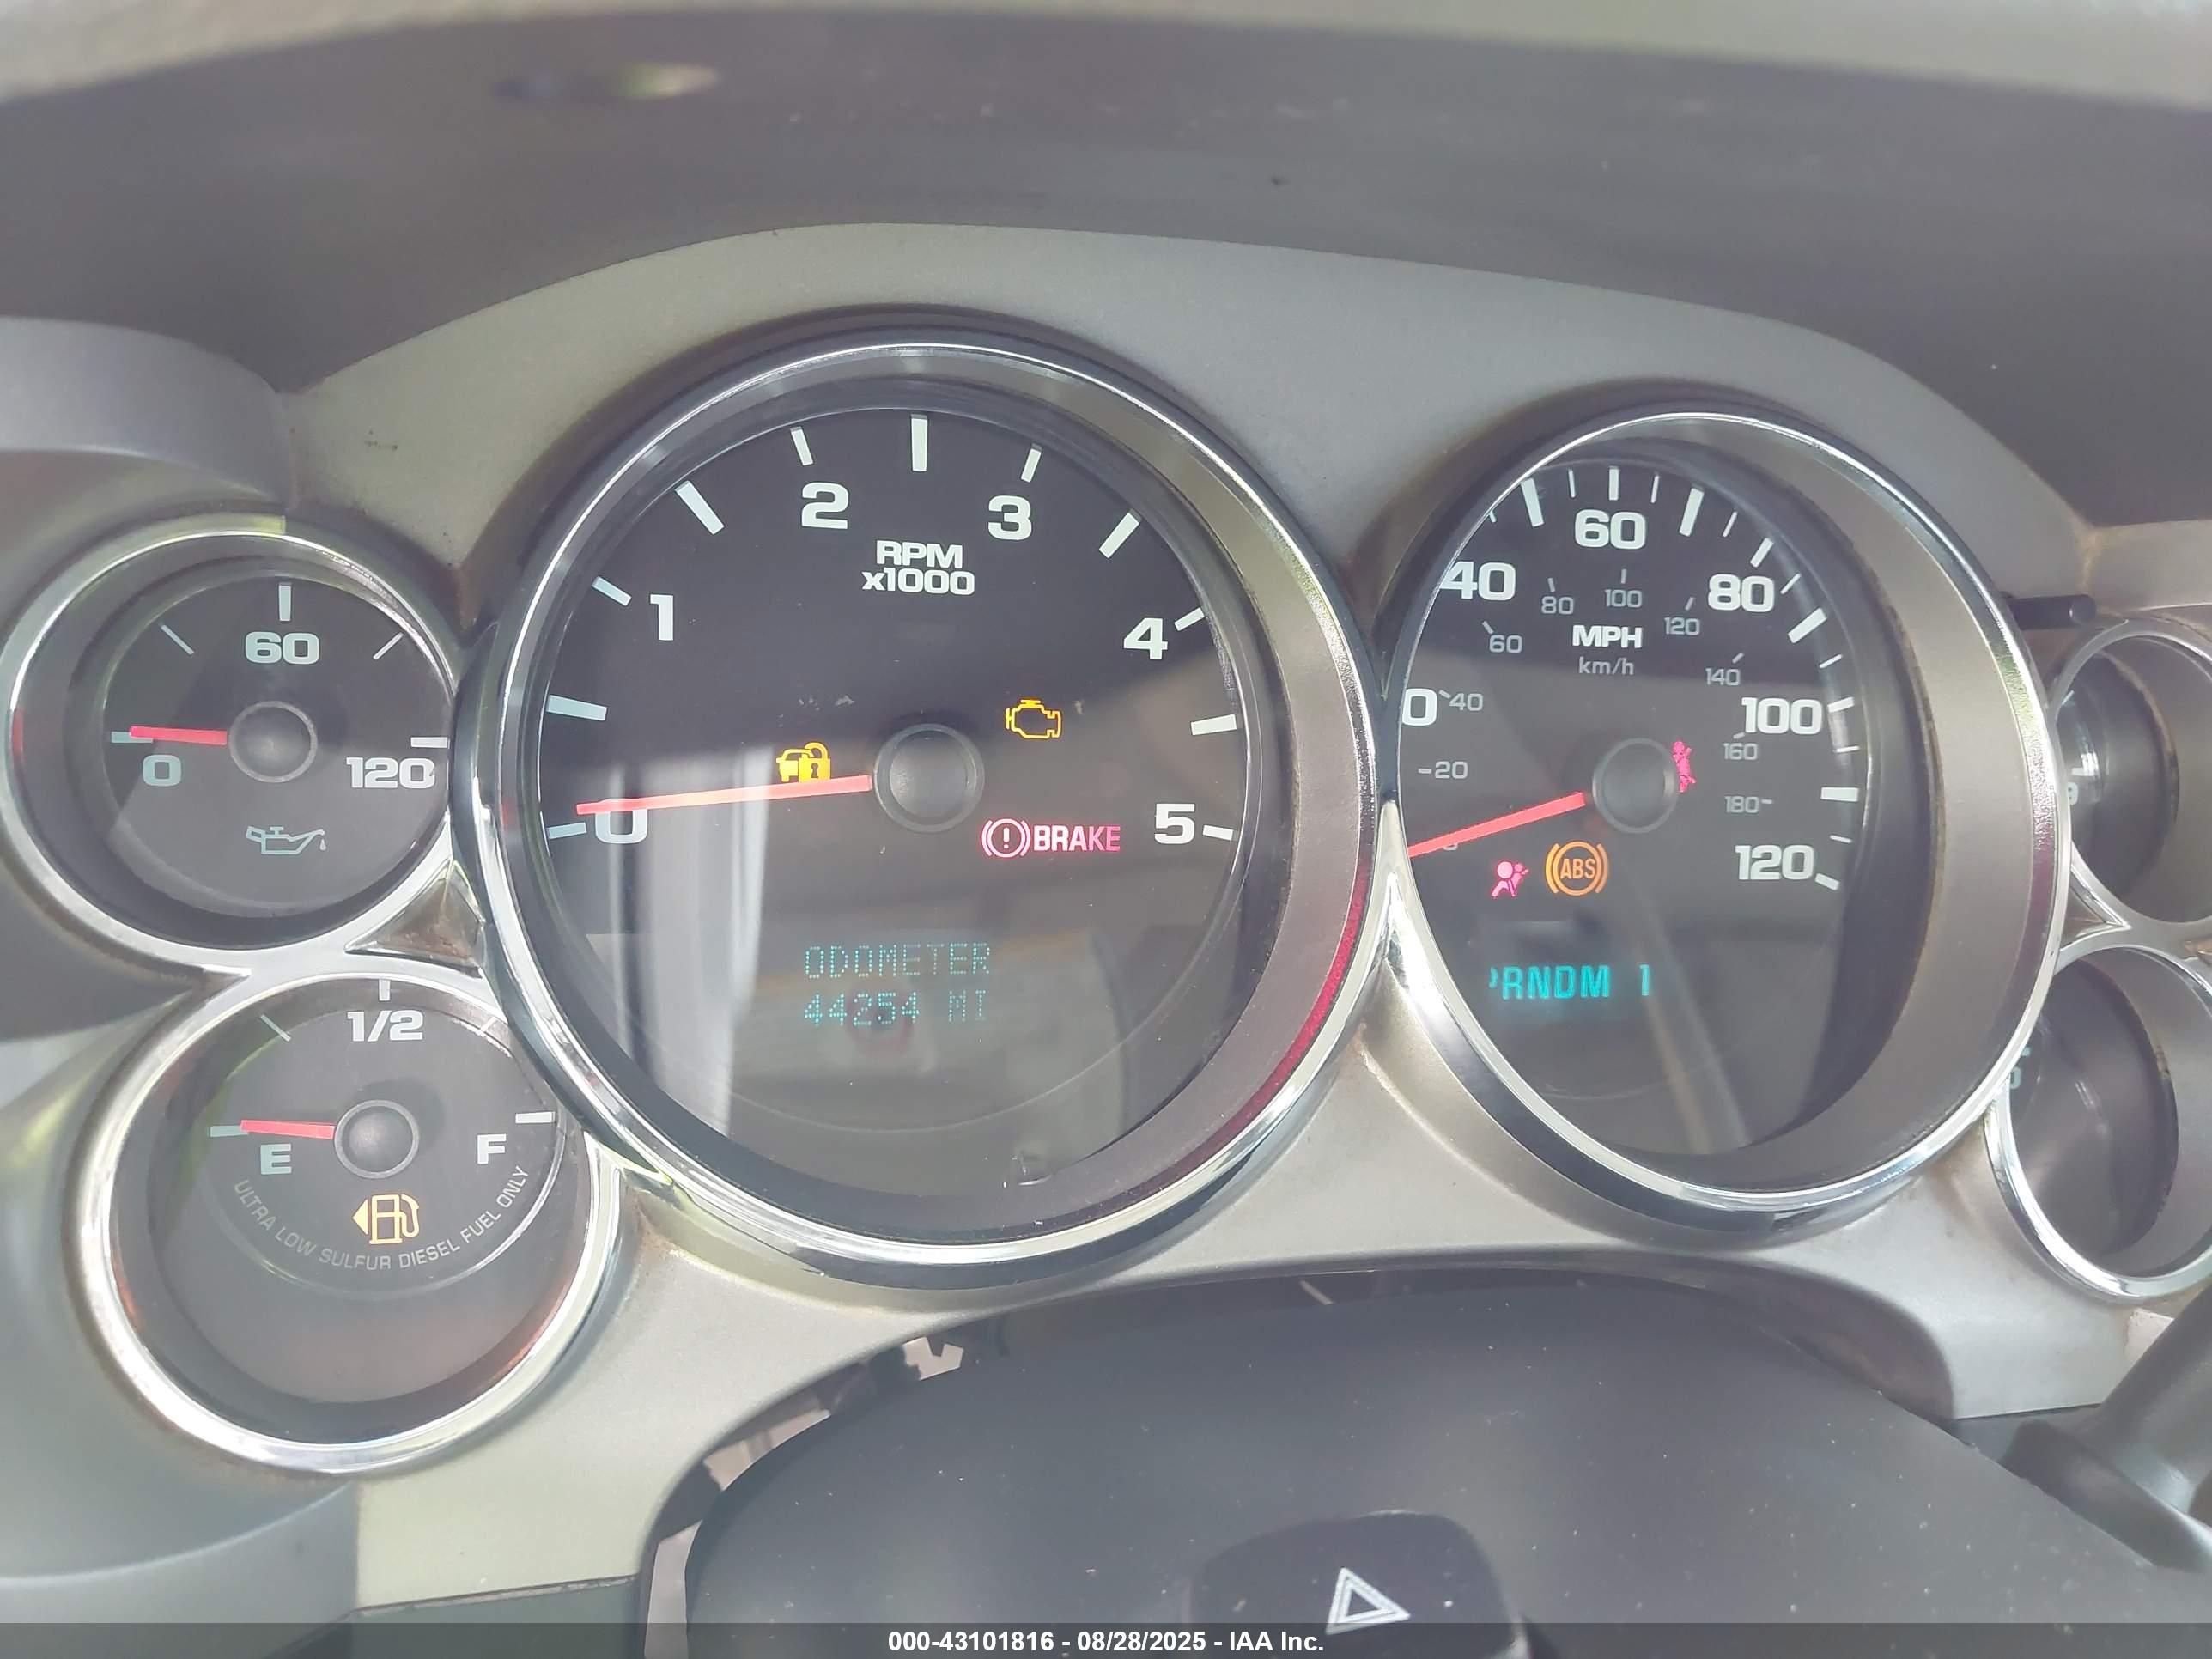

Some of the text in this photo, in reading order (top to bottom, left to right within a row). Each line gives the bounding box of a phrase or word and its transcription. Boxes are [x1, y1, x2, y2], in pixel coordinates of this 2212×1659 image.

[800, 481, 849, 530] 2
[988, 495, 1033, 541] 3
[1575, 509, 1647, 550] 60
[876, 539, 963, 568] RPM
[861, 568, 975, 596] x1000
[1439, 561, 1517, 601] 40
[1707, 574, 1776, 612] 80
[1541, 596, 1574, 615] 80
[1605, 589, 1642, 609] 100
[649, 594, 674, 641] 1
[1664, 617, 1700, 636] 120
[245, 631, 320, 665] 60
[1122, 617, 1169, 660] 4
[1489, 635, 1523, 653] 60
[1572, 625, 1642, 648] MPH
[1578, 657, 1634, 676] km/h
[1705, 667, 1740, 686] 140
[1449, 693, 1484, 711] 40
[1741, 697, 1822, 735] 100
[1723, 743, 1758, 761] 160
[143, 754, 182, 787] 0
[346, 757, 436, 789] 120
[1435, 761, 1468, 779] 20
[1725, 796, 1759, 814] 180
[1033, 825, 1121, 852] BRAKE
[1154, 802, 1196, 846] 5
[1560, 859, 1597, 880] ABS
[1735, 845, 1817, 880] 120
[804, 942, 990, 979] ODOMETER
[804, 990, 987, 1026] 44254 MI
[346, 1010, 425, 1042] 1/2
[260, 1143, 292, 1176] E
[477, 1133, 507, 1164] F
[234, 1165, 529, 1271] ULTRA LOW SULFUR DIESEL FUEL ONLY
